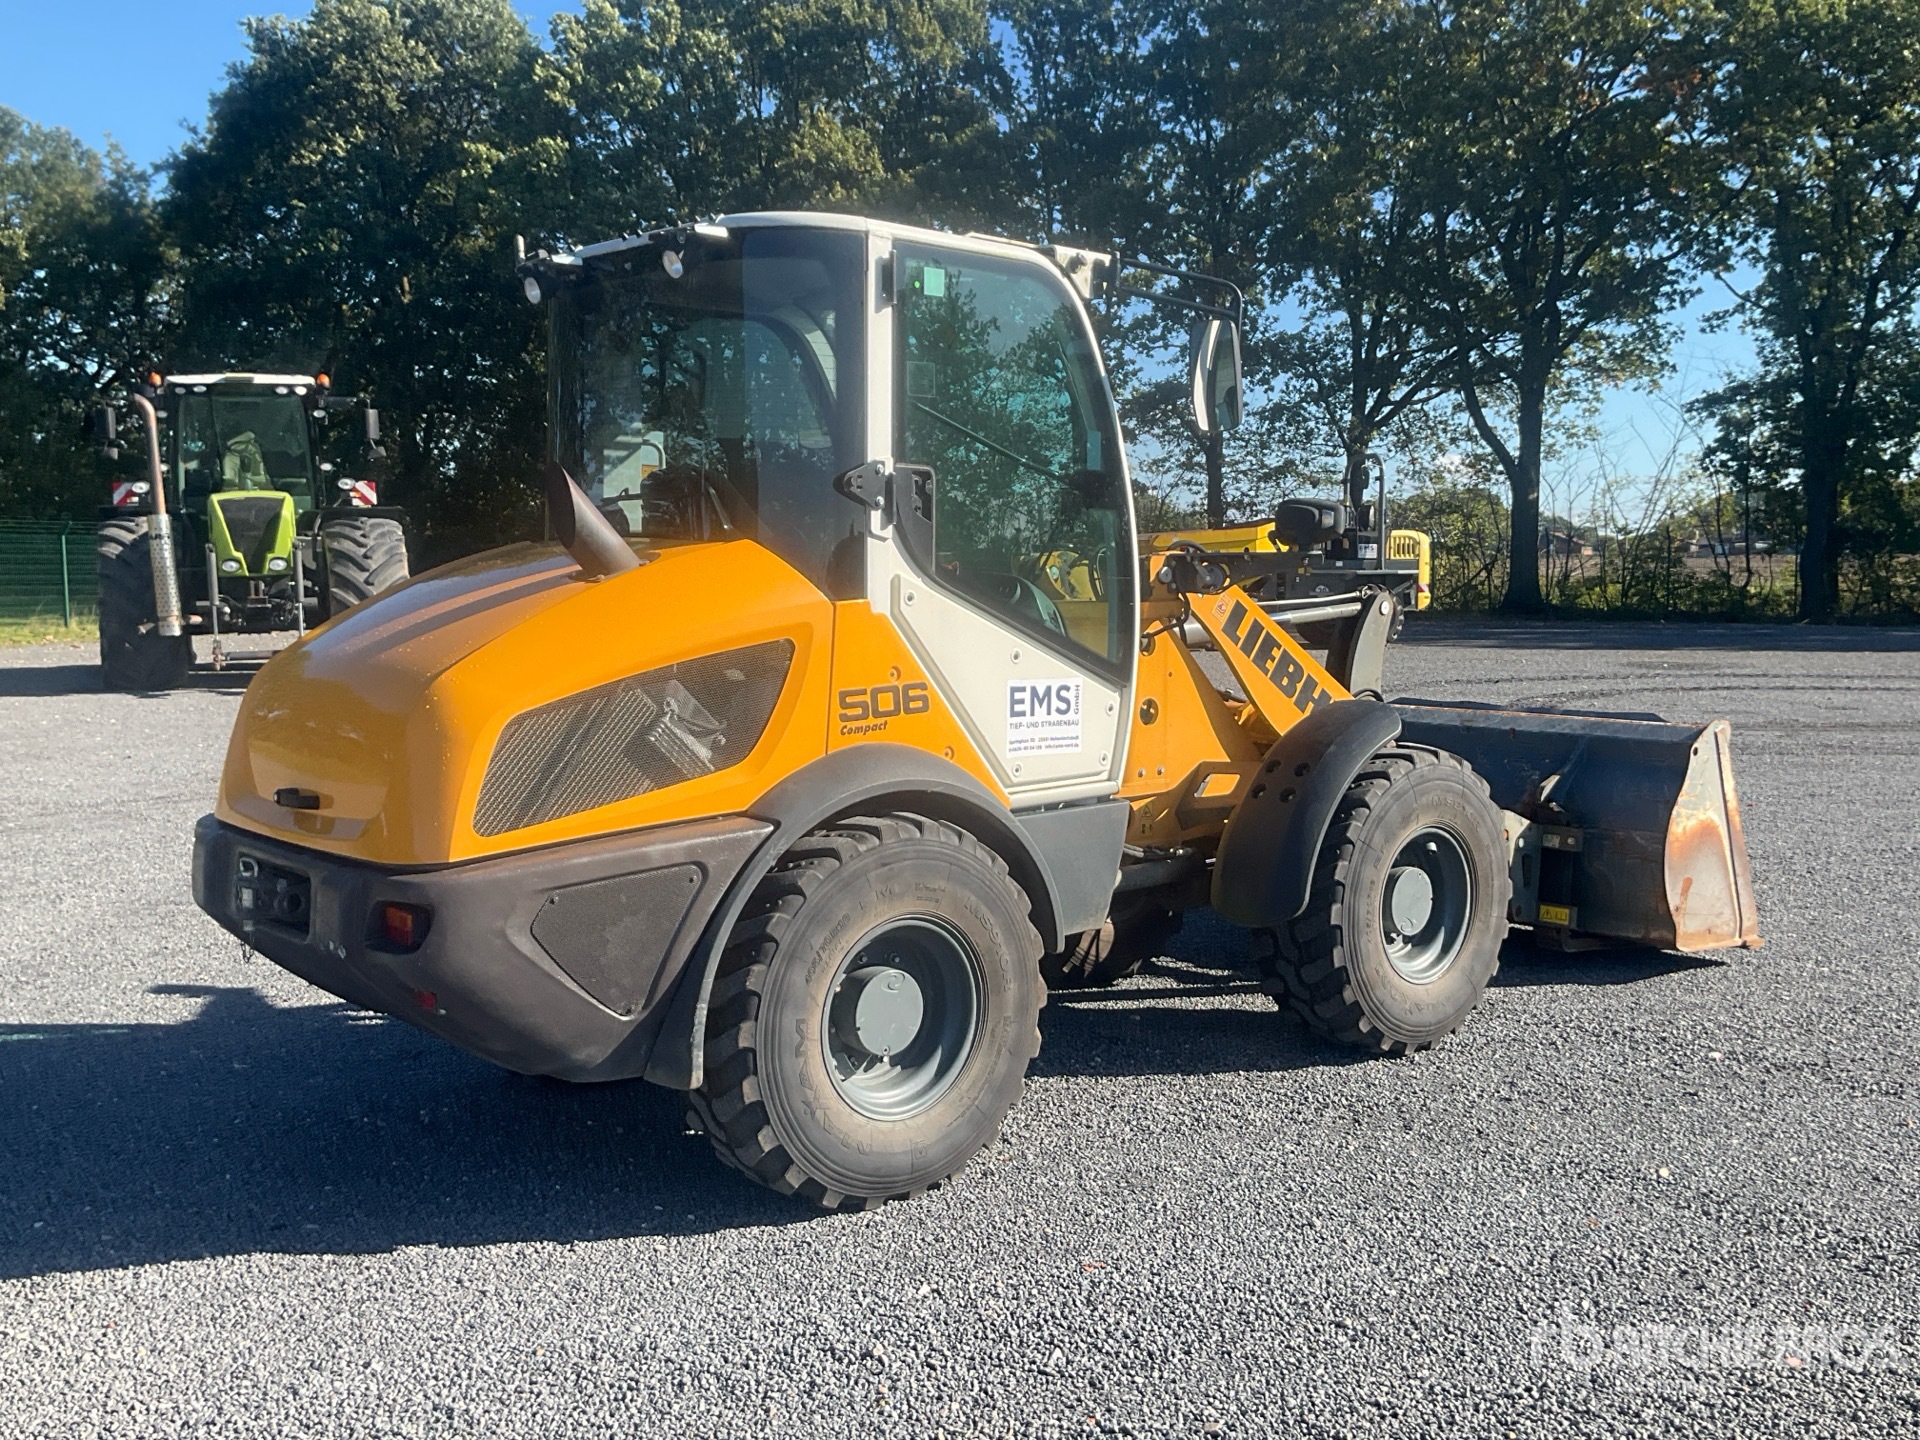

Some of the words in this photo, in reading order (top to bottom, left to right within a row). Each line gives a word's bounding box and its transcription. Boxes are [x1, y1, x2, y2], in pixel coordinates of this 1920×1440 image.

[838, 682, 930, 722] 506
[1009, 684, 1071, 717] EMS
[1073, 684, 1081, 715] GmbH
[840, 720, 888, 736] Compact
[1009, 722, 1025, 730] TIEF-
[1026, 721, 1040, 729] UND
